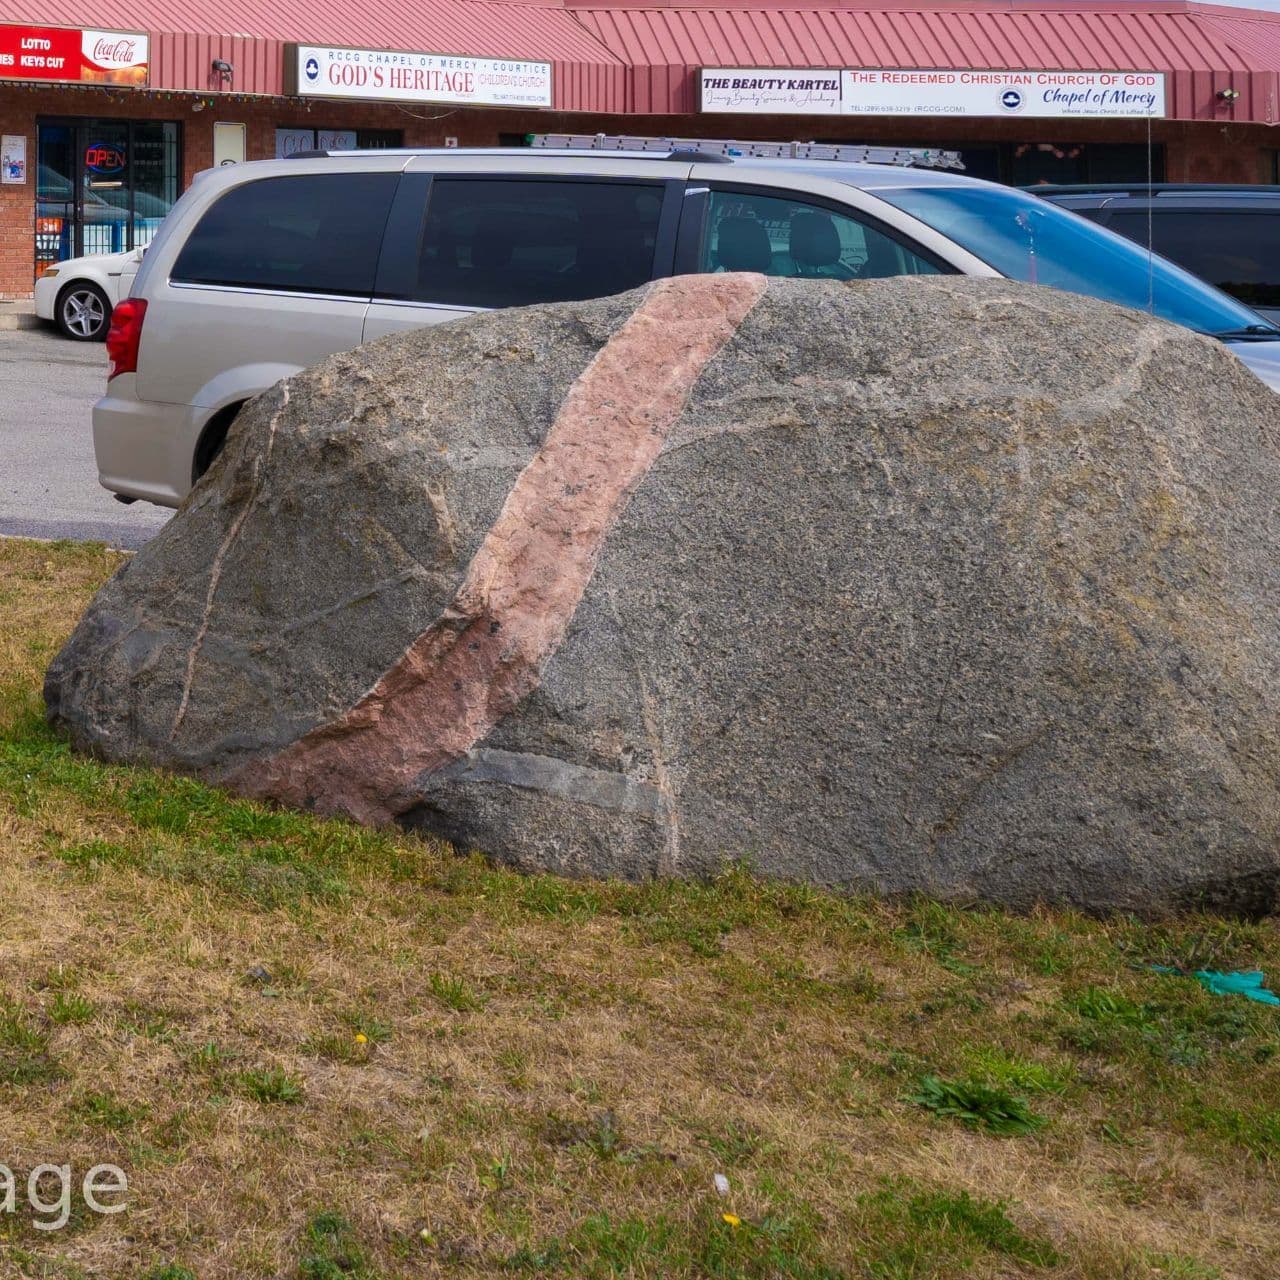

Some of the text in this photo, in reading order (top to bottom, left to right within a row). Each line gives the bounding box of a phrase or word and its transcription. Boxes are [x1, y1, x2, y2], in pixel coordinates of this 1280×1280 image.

[21, 38, 51, 49] LOTTO
[21, 55, 45, 67] KEYS
[46, 57, 65, 68] CUT
[329, 51, 547, 74] RCCG CHAPEL OF MERCY COURTICE
[328, 63, 384, 88] GOD'S
[390, 67, 475, 93] HERITAGE
[703, 78, 839, 91] THE BEAUTY KARTEL
[850, 72, 1155, 86] THE REDEEMED CHRISTIAN CHURCH OF GOD
[1043, 88, 1090, 105] Chapel
[1092, 89, 1108, 105] of
[1111, 89, 1156, 108] Mercy
[86, 149, 126, 167] OPEN
